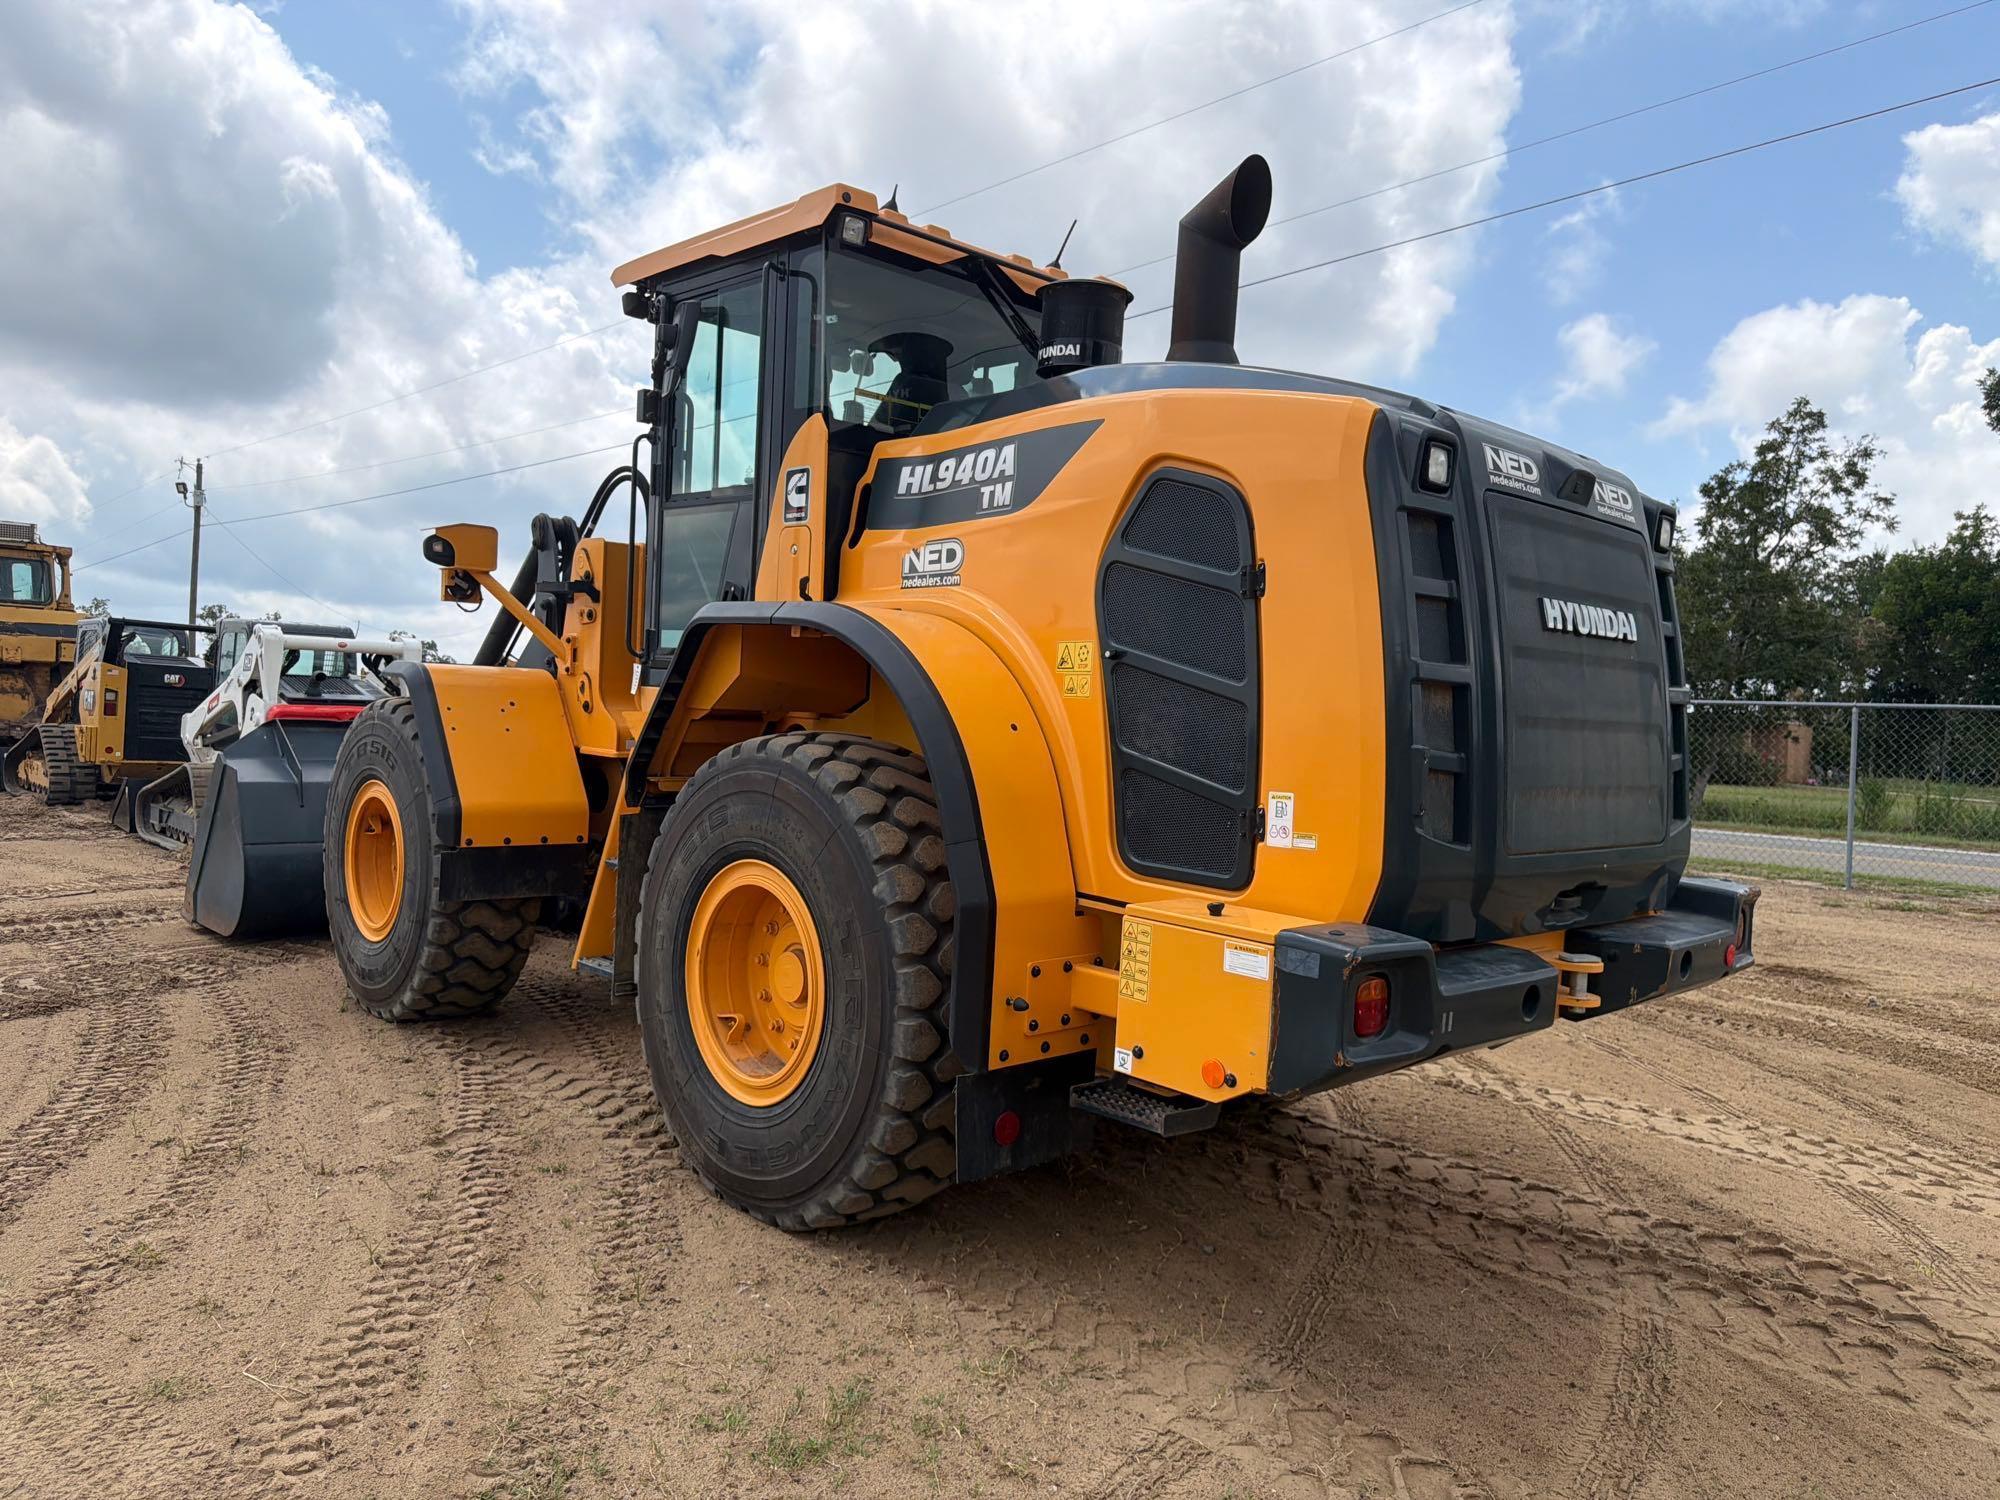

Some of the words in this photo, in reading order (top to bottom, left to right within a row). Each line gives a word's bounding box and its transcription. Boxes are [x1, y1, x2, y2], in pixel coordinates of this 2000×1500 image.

[1038, 344, 1080, 360] YUNDAI
[897, 444, 1015, 495] HL940A
[1483, 444, 1539, 483] NED
[980, 481, 1013, 510] TM
[1489, 475, 1541, 496] nedealers.com
[1593, 481, 1633, 512] NED
[1597, 505, 1636, 524] nedealers.com
[904, 541, 962, 573] NED
[902, 574, 960, 588] nedealers.com
[1542, 597, 1638, 642] HYUNDAI
[164, 673, 180, 683] CAT
